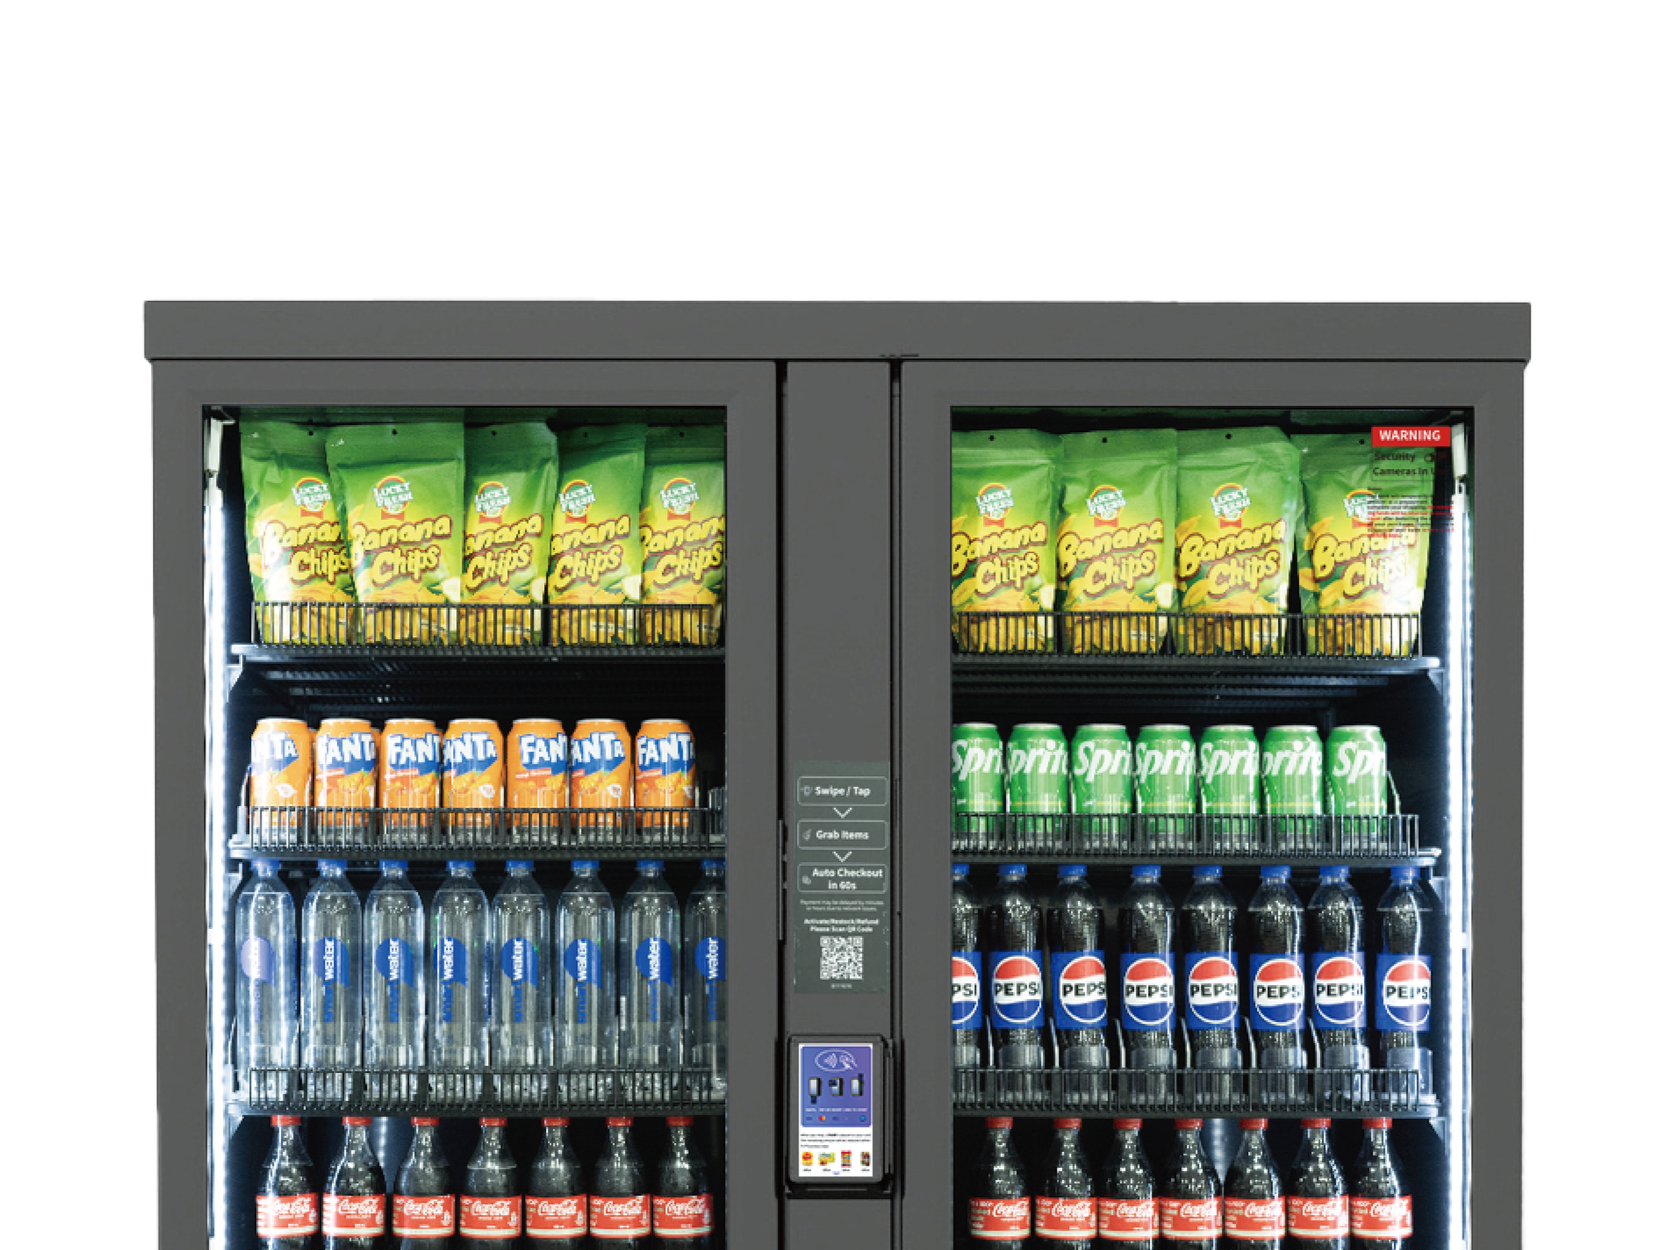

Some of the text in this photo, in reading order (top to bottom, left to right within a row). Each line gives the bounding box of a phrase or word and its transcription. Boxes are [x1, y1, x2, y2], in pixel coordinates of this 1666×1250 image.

[1374, 451, 1416, 462] Security
[1379, 430, 1441, 441] WARNING
[1373, 466, 1417, 476] Cameras
[371, 545, 441, 586] Chips
[466, 542, 534, 590] Chips
[554, 544, 623, 590] Chips
[653, 541, 723, 587] Chips
[1057, 518, 1164, 581] Banana
[1178, 518, 1287, 581] Banana
[1312, 525, 1417, 582] Banana
[975, 552, 1039, 596] Chips
[1083, 549, 1156, 596] Chips
[1206, 549, 1281, 598] Chips
[814, 785, 871, 798] Swipe / Tap
[816, 830, 869, 840] Grab Items
[812, 868, 883, 877] Auto Checkout
[839, 880, 857, 890] 60s
[323, 938, 334, 980] water
[388, 938, 399, 980] water
[443, 938, 454, 980] water
[511, 938, 523, 980] water
[576, 938, 587, 982] water
[648, 937, 660, 980] water
[706, 937, 718, 979] water
[1124, 983, 1173, 998] PEPSI
[1190, 983, 1237, 998] PEPSI
